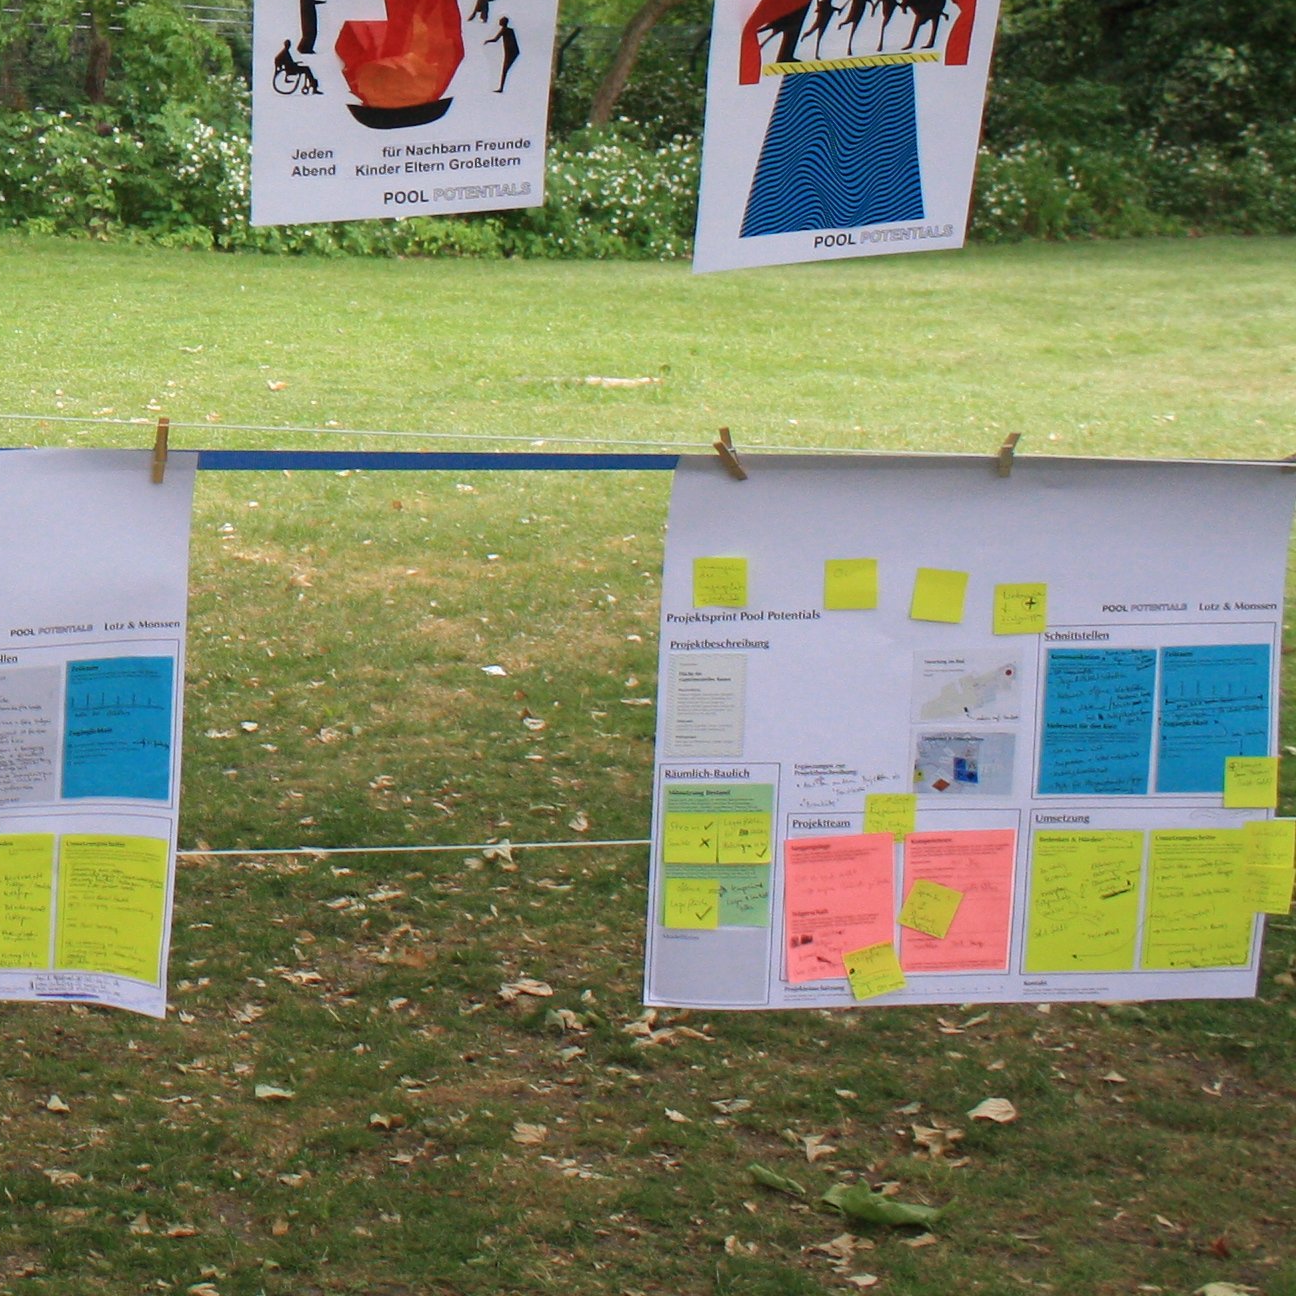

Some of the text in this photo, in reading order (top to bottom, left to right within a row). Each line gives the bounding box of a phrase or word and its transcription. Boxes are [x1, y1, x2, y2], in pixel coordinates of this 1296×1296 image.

[382, 137, 531, 157] für Nachbarn Freunde
[292, 147, 334, 160] Jeden
[292, 165, 336, 177] Abend
[355, 155, 521, 176] Kinder Eltern Großeltern
[383, 182, 531, 205] POOL POTENTIALS
[813, 224, 953, 248] POOL POTENTIALS
[1102, 604, 1128, 612] POOL
[666, 610, 821, 625] Projektsprint Pool Potentials
[10, 628, 35, 636] POOL
[1044, 631, 1109, 641] Schnittstellen
[670, 639, 769, 650] Projektbeschreibung
[665, 769, 750, 778] Räumlich-Baulich
[1035, 813, 1090, 823] Umsetzung
[792, 819, 851, 829] Projektteam
